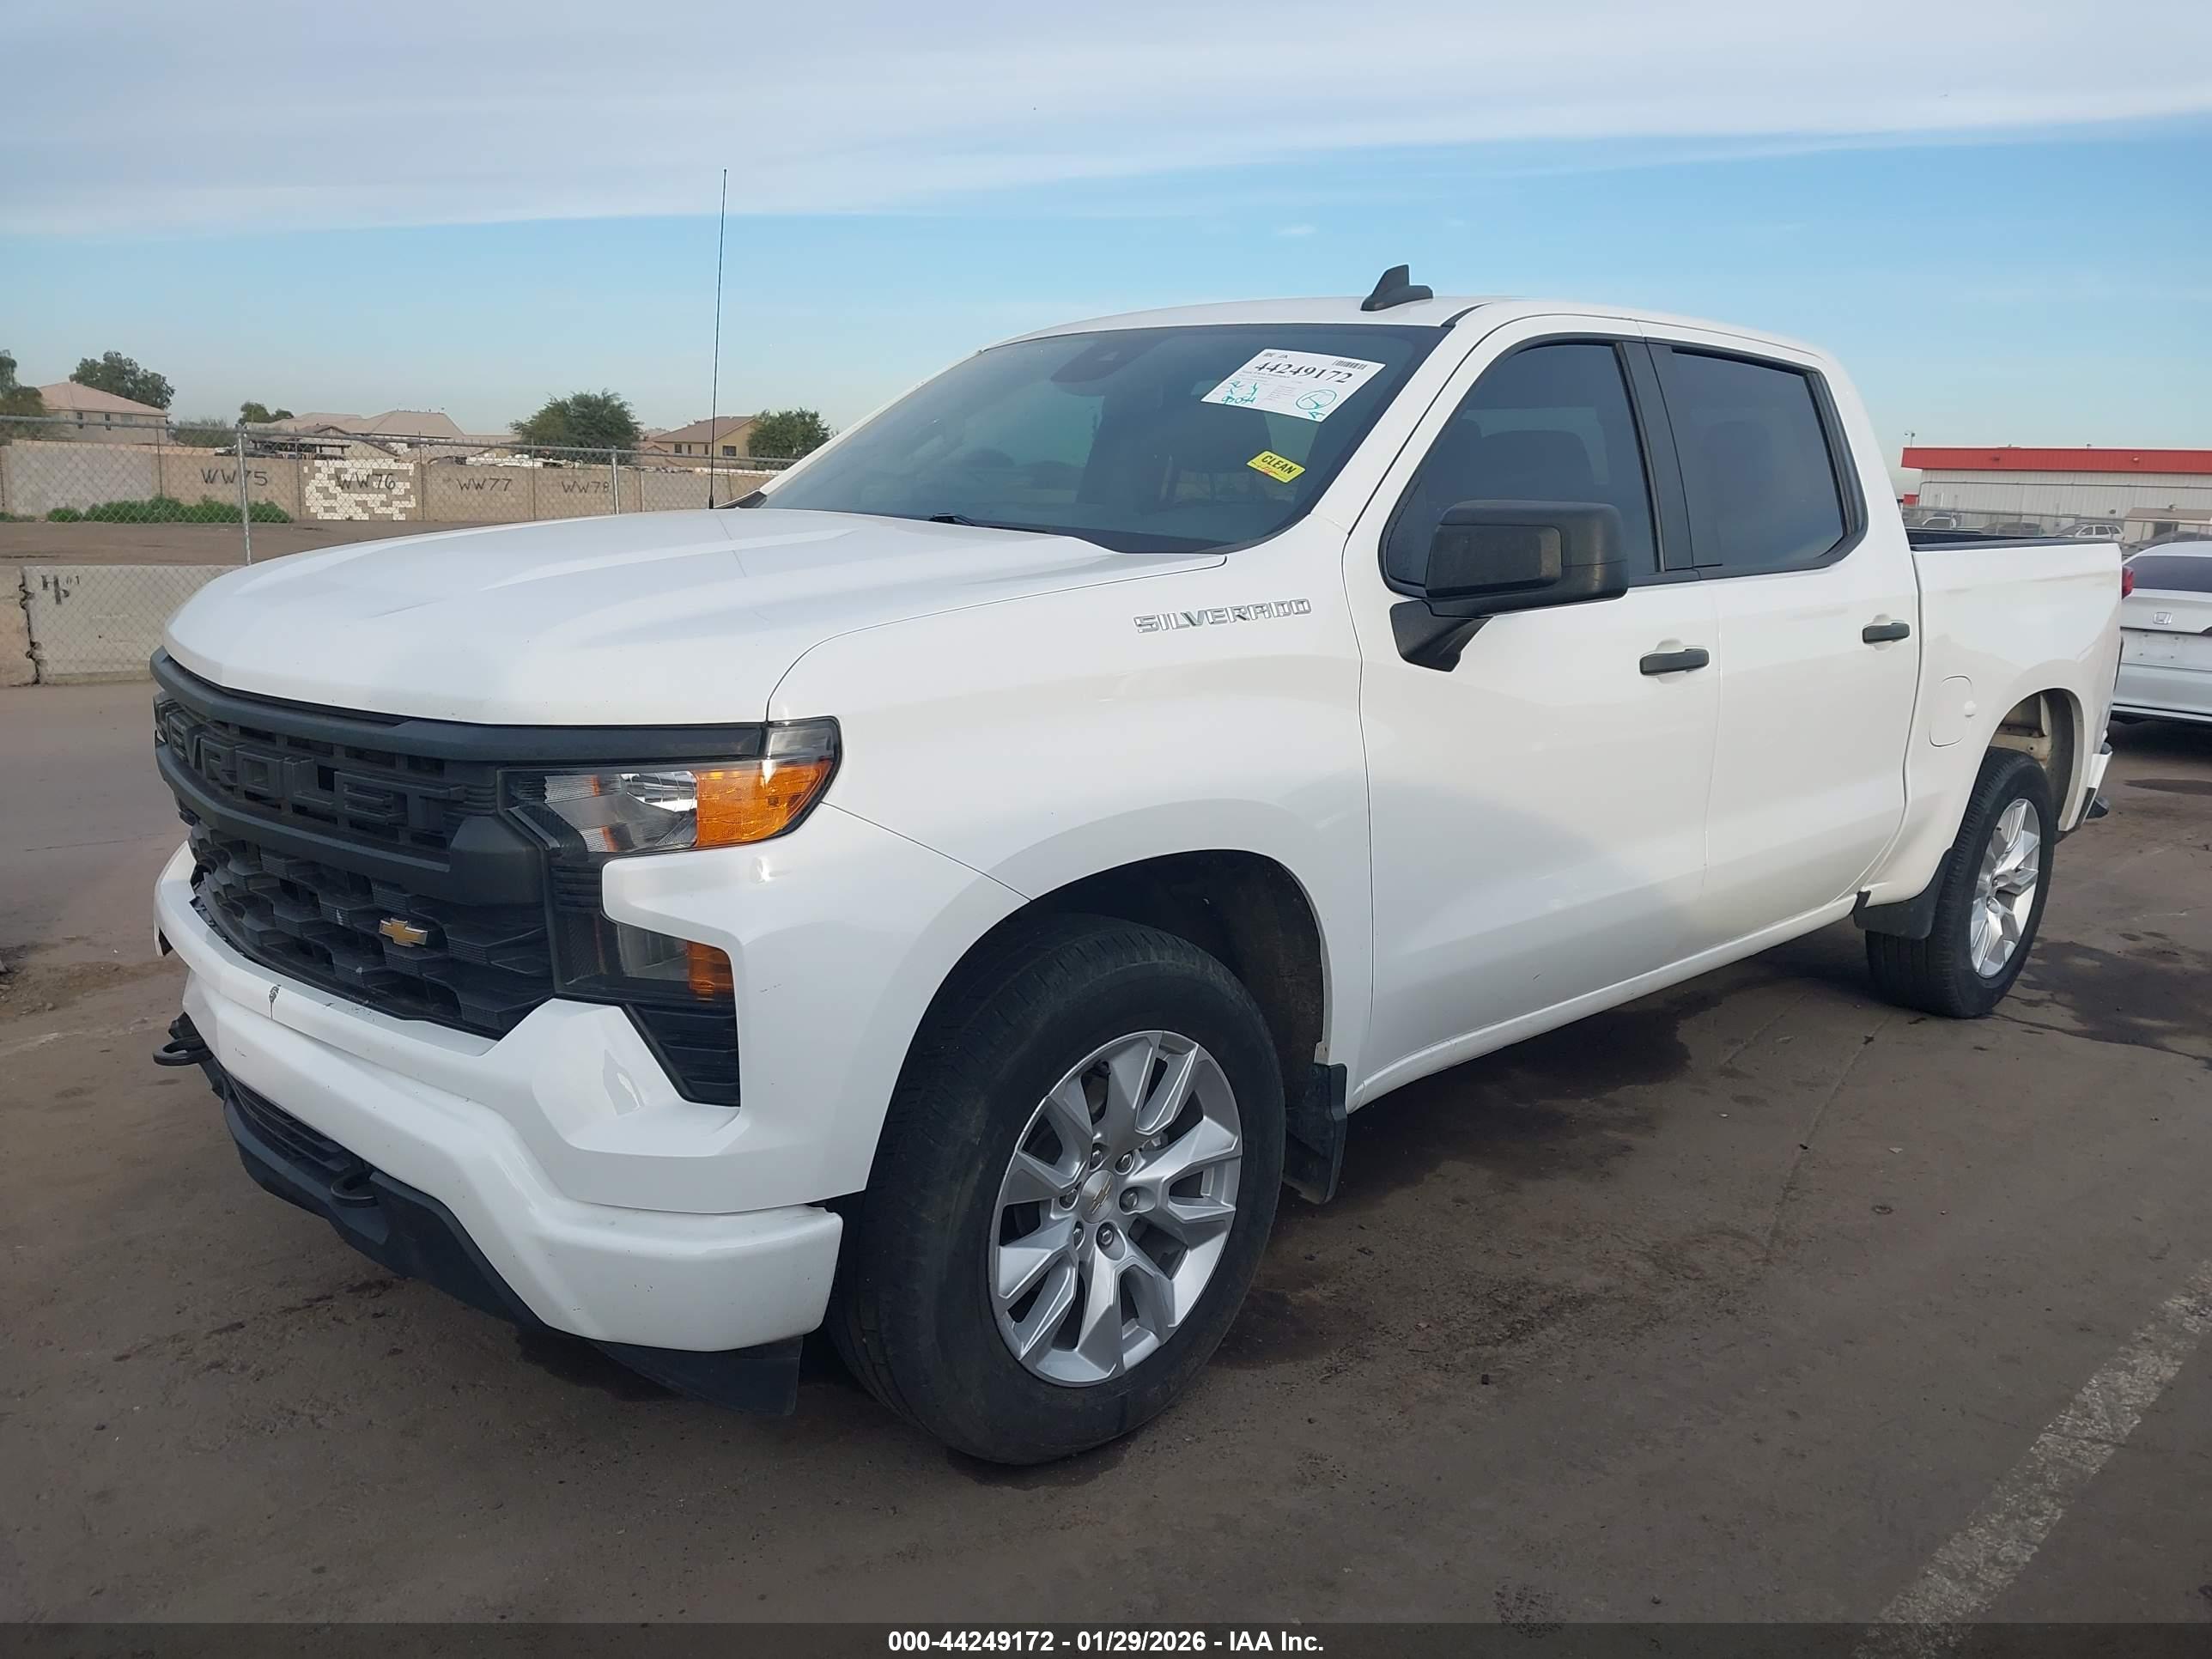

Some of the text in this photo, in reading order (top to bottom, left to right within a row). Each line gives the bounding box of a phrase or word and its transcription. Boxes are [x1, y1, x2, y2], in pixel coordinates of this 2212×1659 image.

[1255, 361, 1352, 384] 44249172
[1261, 454, 1297, 475] CLEAN
[334, 471, 396, 490] WW76
[456, 477, 513, 492] WW77
[561, 480, 611, 495] WW78
[1133, 598, 1312, 634] SILVERADO
